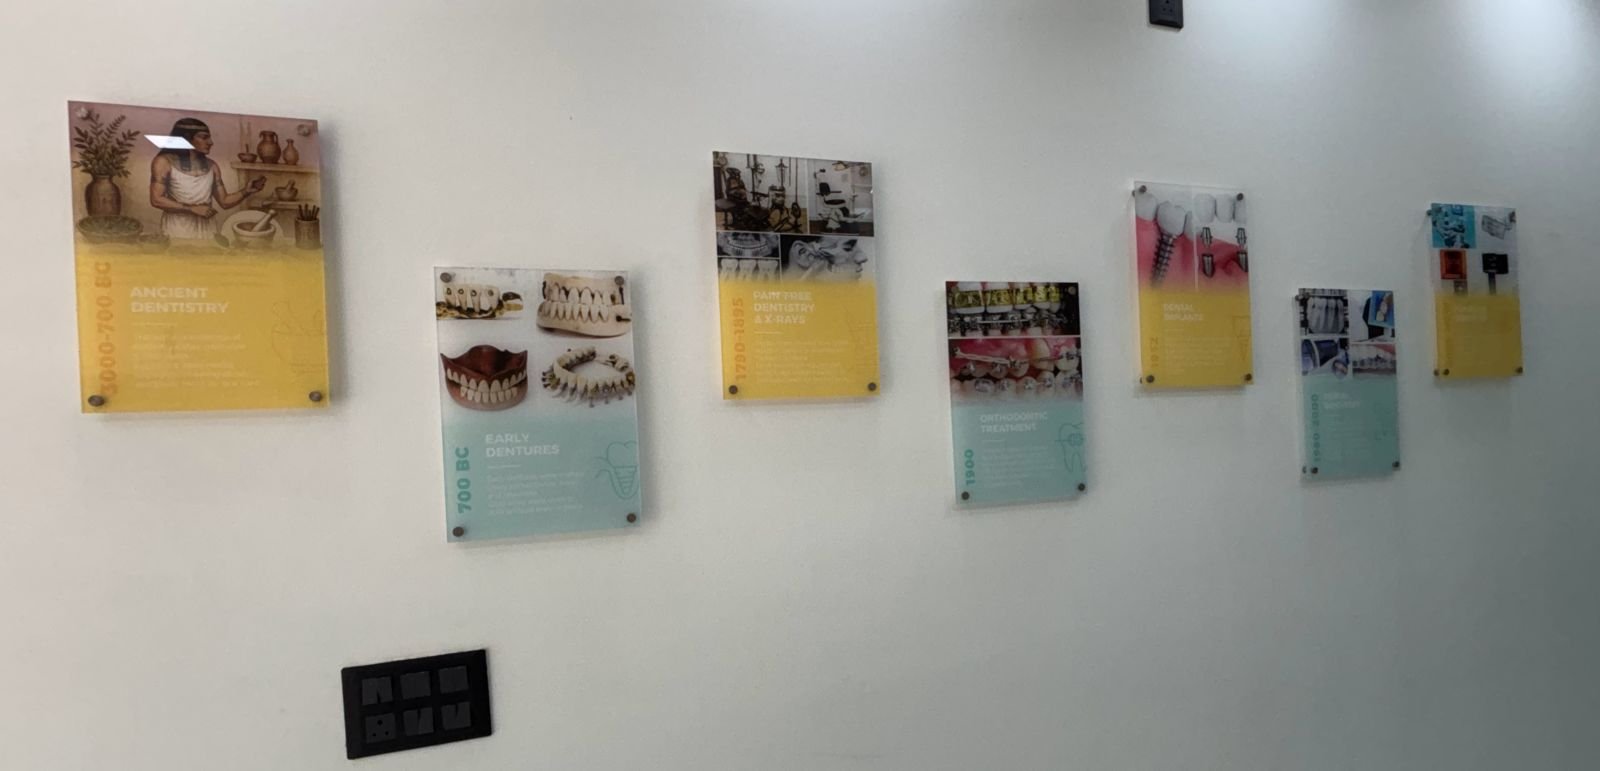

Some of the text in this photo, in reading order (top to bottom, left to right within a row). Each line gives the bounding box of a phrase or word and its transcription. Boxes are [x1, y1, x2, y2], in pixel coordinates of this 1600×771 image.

[130, 287, 209, 298] ANCIENT
[131, 302, 229, 313] DENTISTRY
[753, 303, 816, 313] DENTISTRY
[733, 297, 747, 381] 1790-1895
[980, 411, 1048, 423] ORTHODONTIC
[981, 422, 1037, 433] TREATMENT
[485, 432, 529, 445] EARLY
[486, 444, 560, 457] DENTURES
[964, 449, 976, 486] 1900
[455, 447, 472, 514] 700 BC
